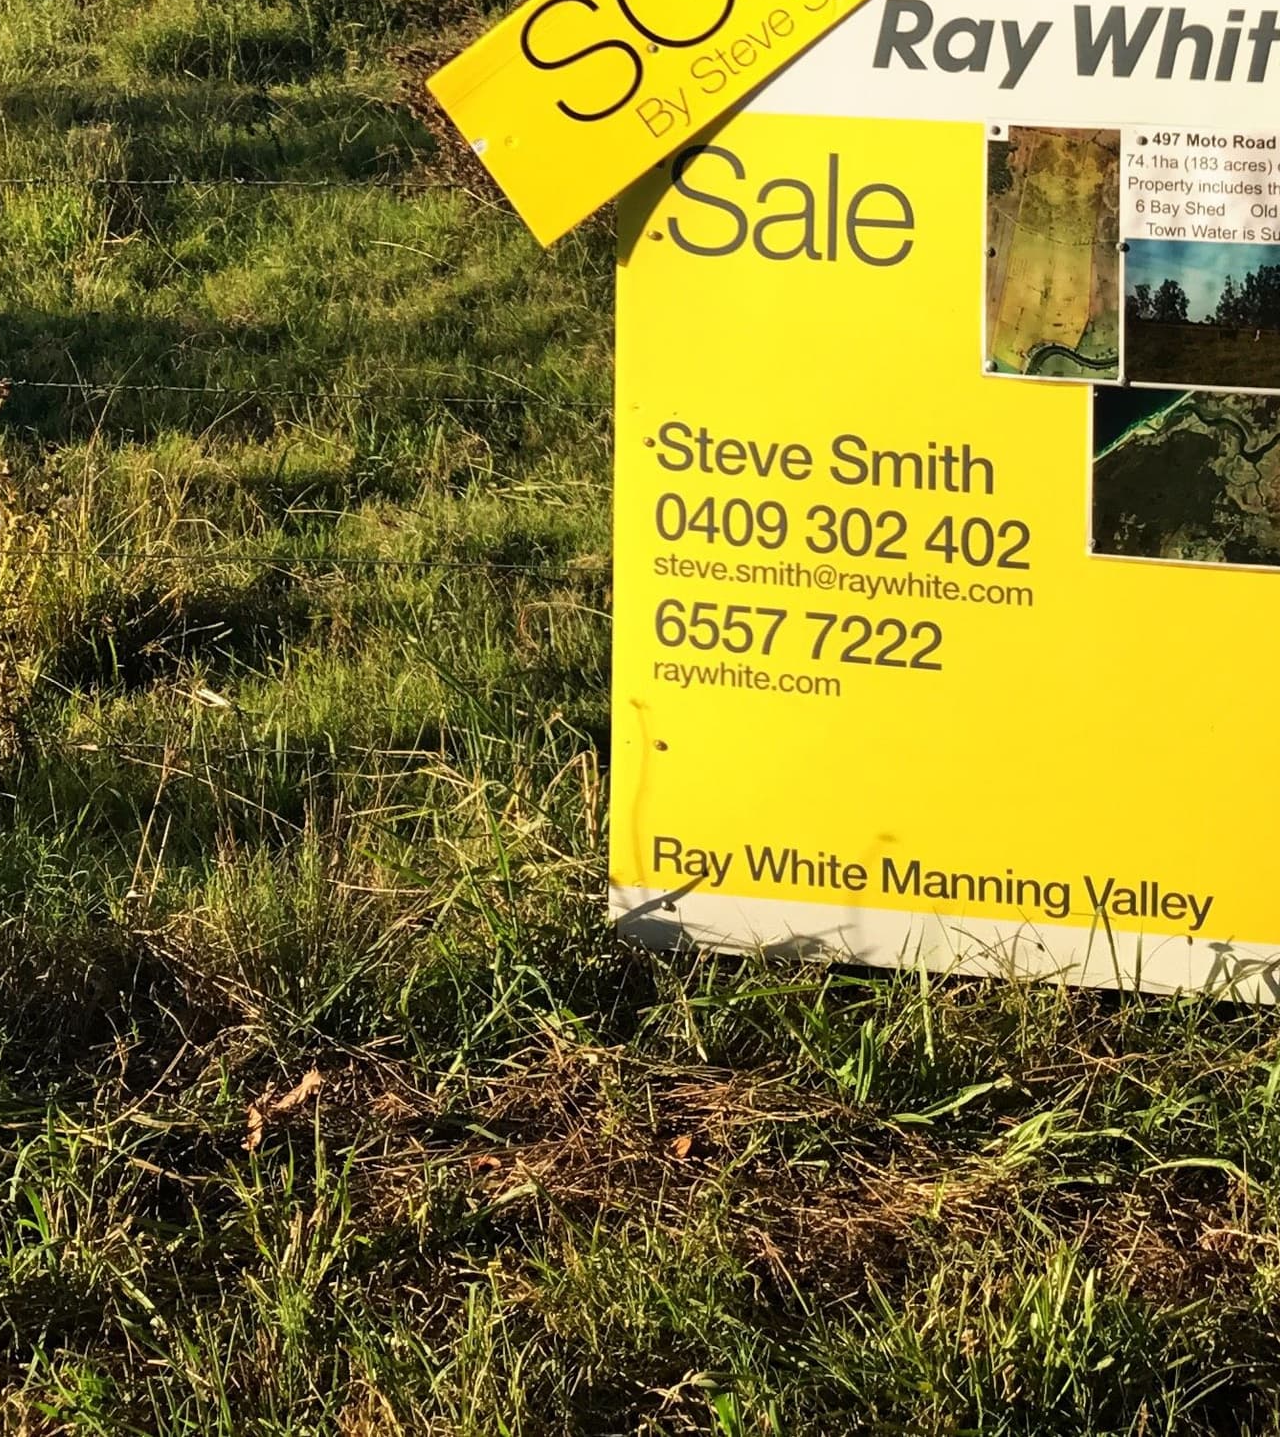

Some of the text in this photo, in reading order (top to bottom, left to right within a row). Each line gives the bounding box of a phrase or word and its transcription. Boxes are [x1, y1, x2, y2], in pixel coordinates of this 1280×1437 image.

[635, 87, 691, 138] By
[690, 8, 795, 95] Steve
[1152, 132, 1181, 147] 497
[1186, 134, 1227, 149] Moto
[1233, 135, 1277, 150] Road
[1126, 154, 1179, 170] 74.1ha
[1184, 155, 1218, 172] (183
[1223, 156, 1273, 175] acres)
[1127, 176, 1194, 195] Property
[1198, 180, 1263, 196] includes
[667, 144, 915, 267] Sale
[1135, 199, 1226, 218] 6 Bay Shed
[1250, 203, 1278, 219] Old
[1146, 223, 1187, 238] Town
[1191, 224, 1238, 240] Water
[1242, 226, 1256, 240] is
[656, 421, 994, 495] Steve Smith
[655, 492, 1031, 570] 0409 302 402
[653, 552, 1034, 606] steve.smith@raywhite.com
[655, 598, 943, 671] 6557 7222
[653, 660, 841, 697] raywhite.com
[652, 836, 1214, 931] Ray White Manning Valley
